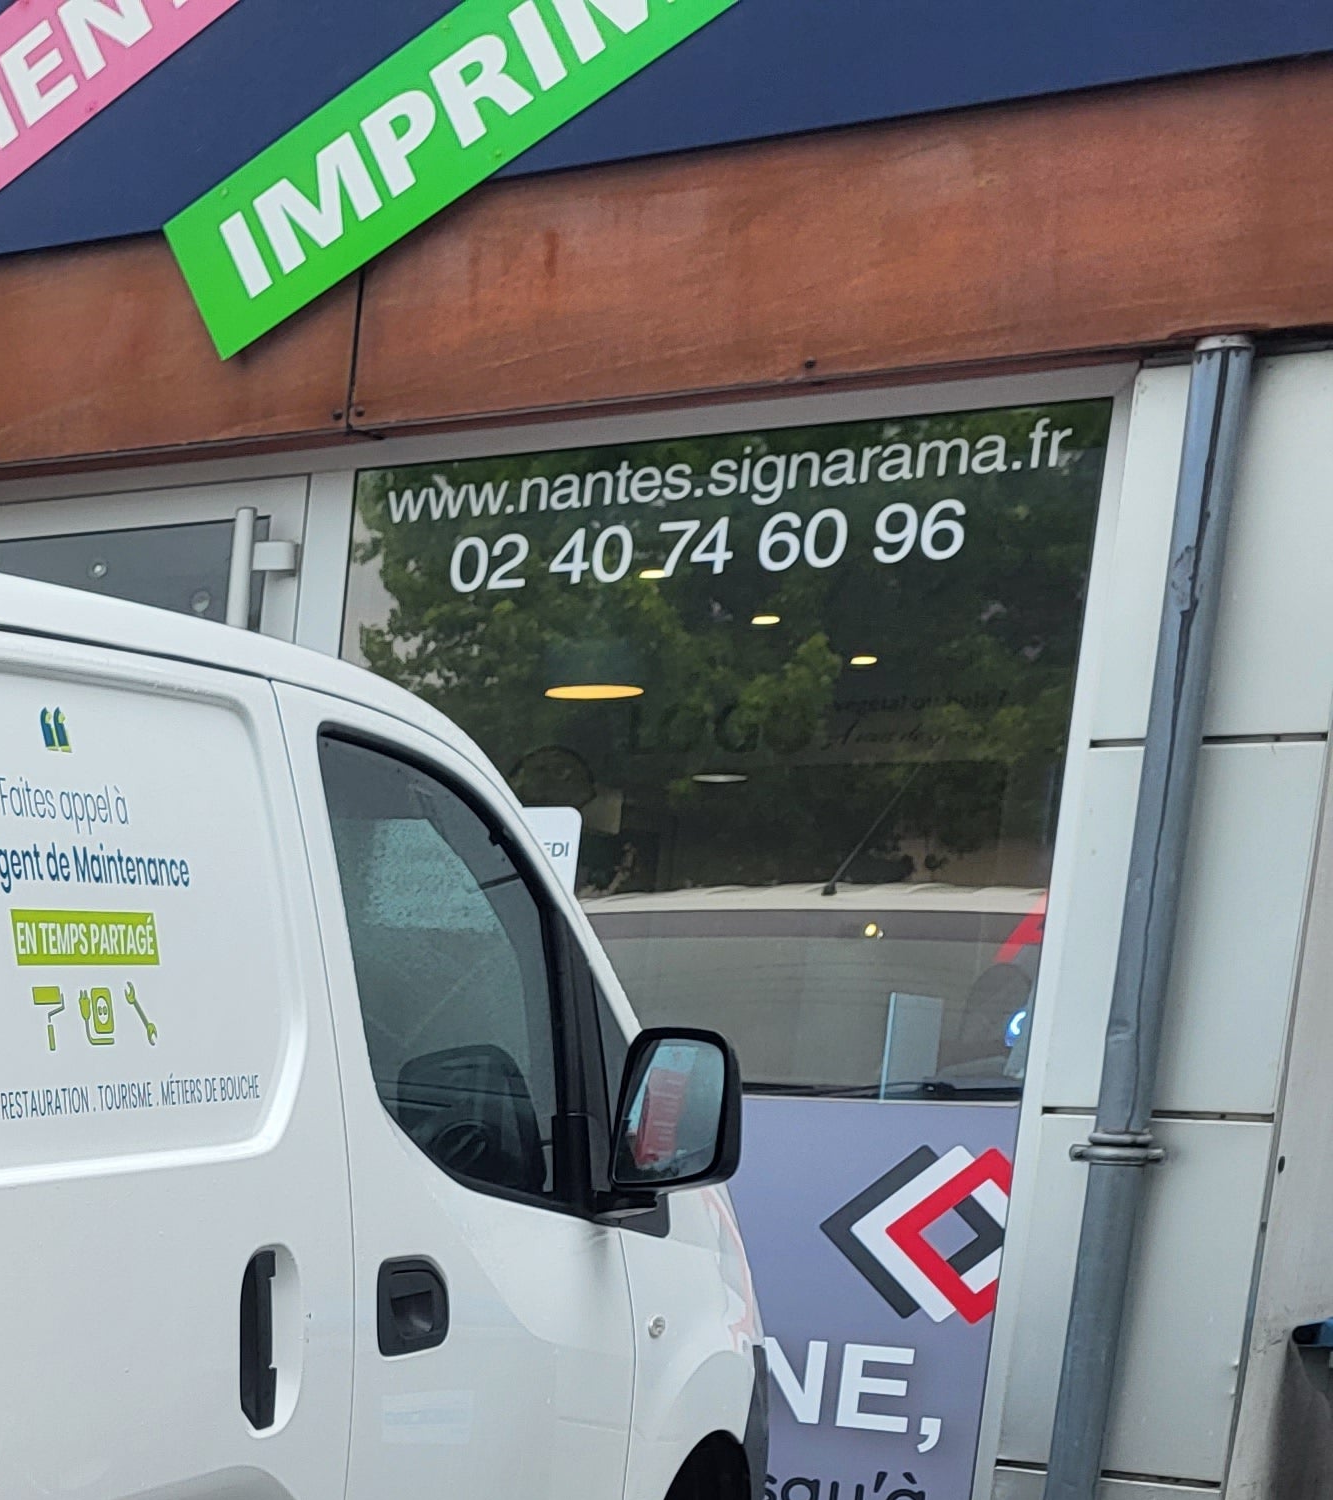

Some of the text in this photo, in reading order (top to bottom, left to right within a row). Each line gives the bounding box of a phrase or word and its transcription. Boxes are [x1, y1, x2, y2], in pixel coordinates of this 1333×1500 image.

[388, 417, 1073, 524] www.nantes.signarama.fr
[450, 499, 968, 594] 02 40 74 60 96
[59, 785, 112, 834] appel
[115, 785, 130, 826] à
[46, 842, 71, 883] de
[73, 843, 191, 888] Maintenance
[16, 916, 156, 958] EN TEMPS PARTAGÉ
[1, 1087, 90, 1121] RESTAURATION
[97, 1081, 153, 1113] TOURISME
[161, 1072, 203, 1106] MÉTIERS
[204, 1077, 218, 1103] DE
[220, 1074, 261, 1101] BOUCHE
